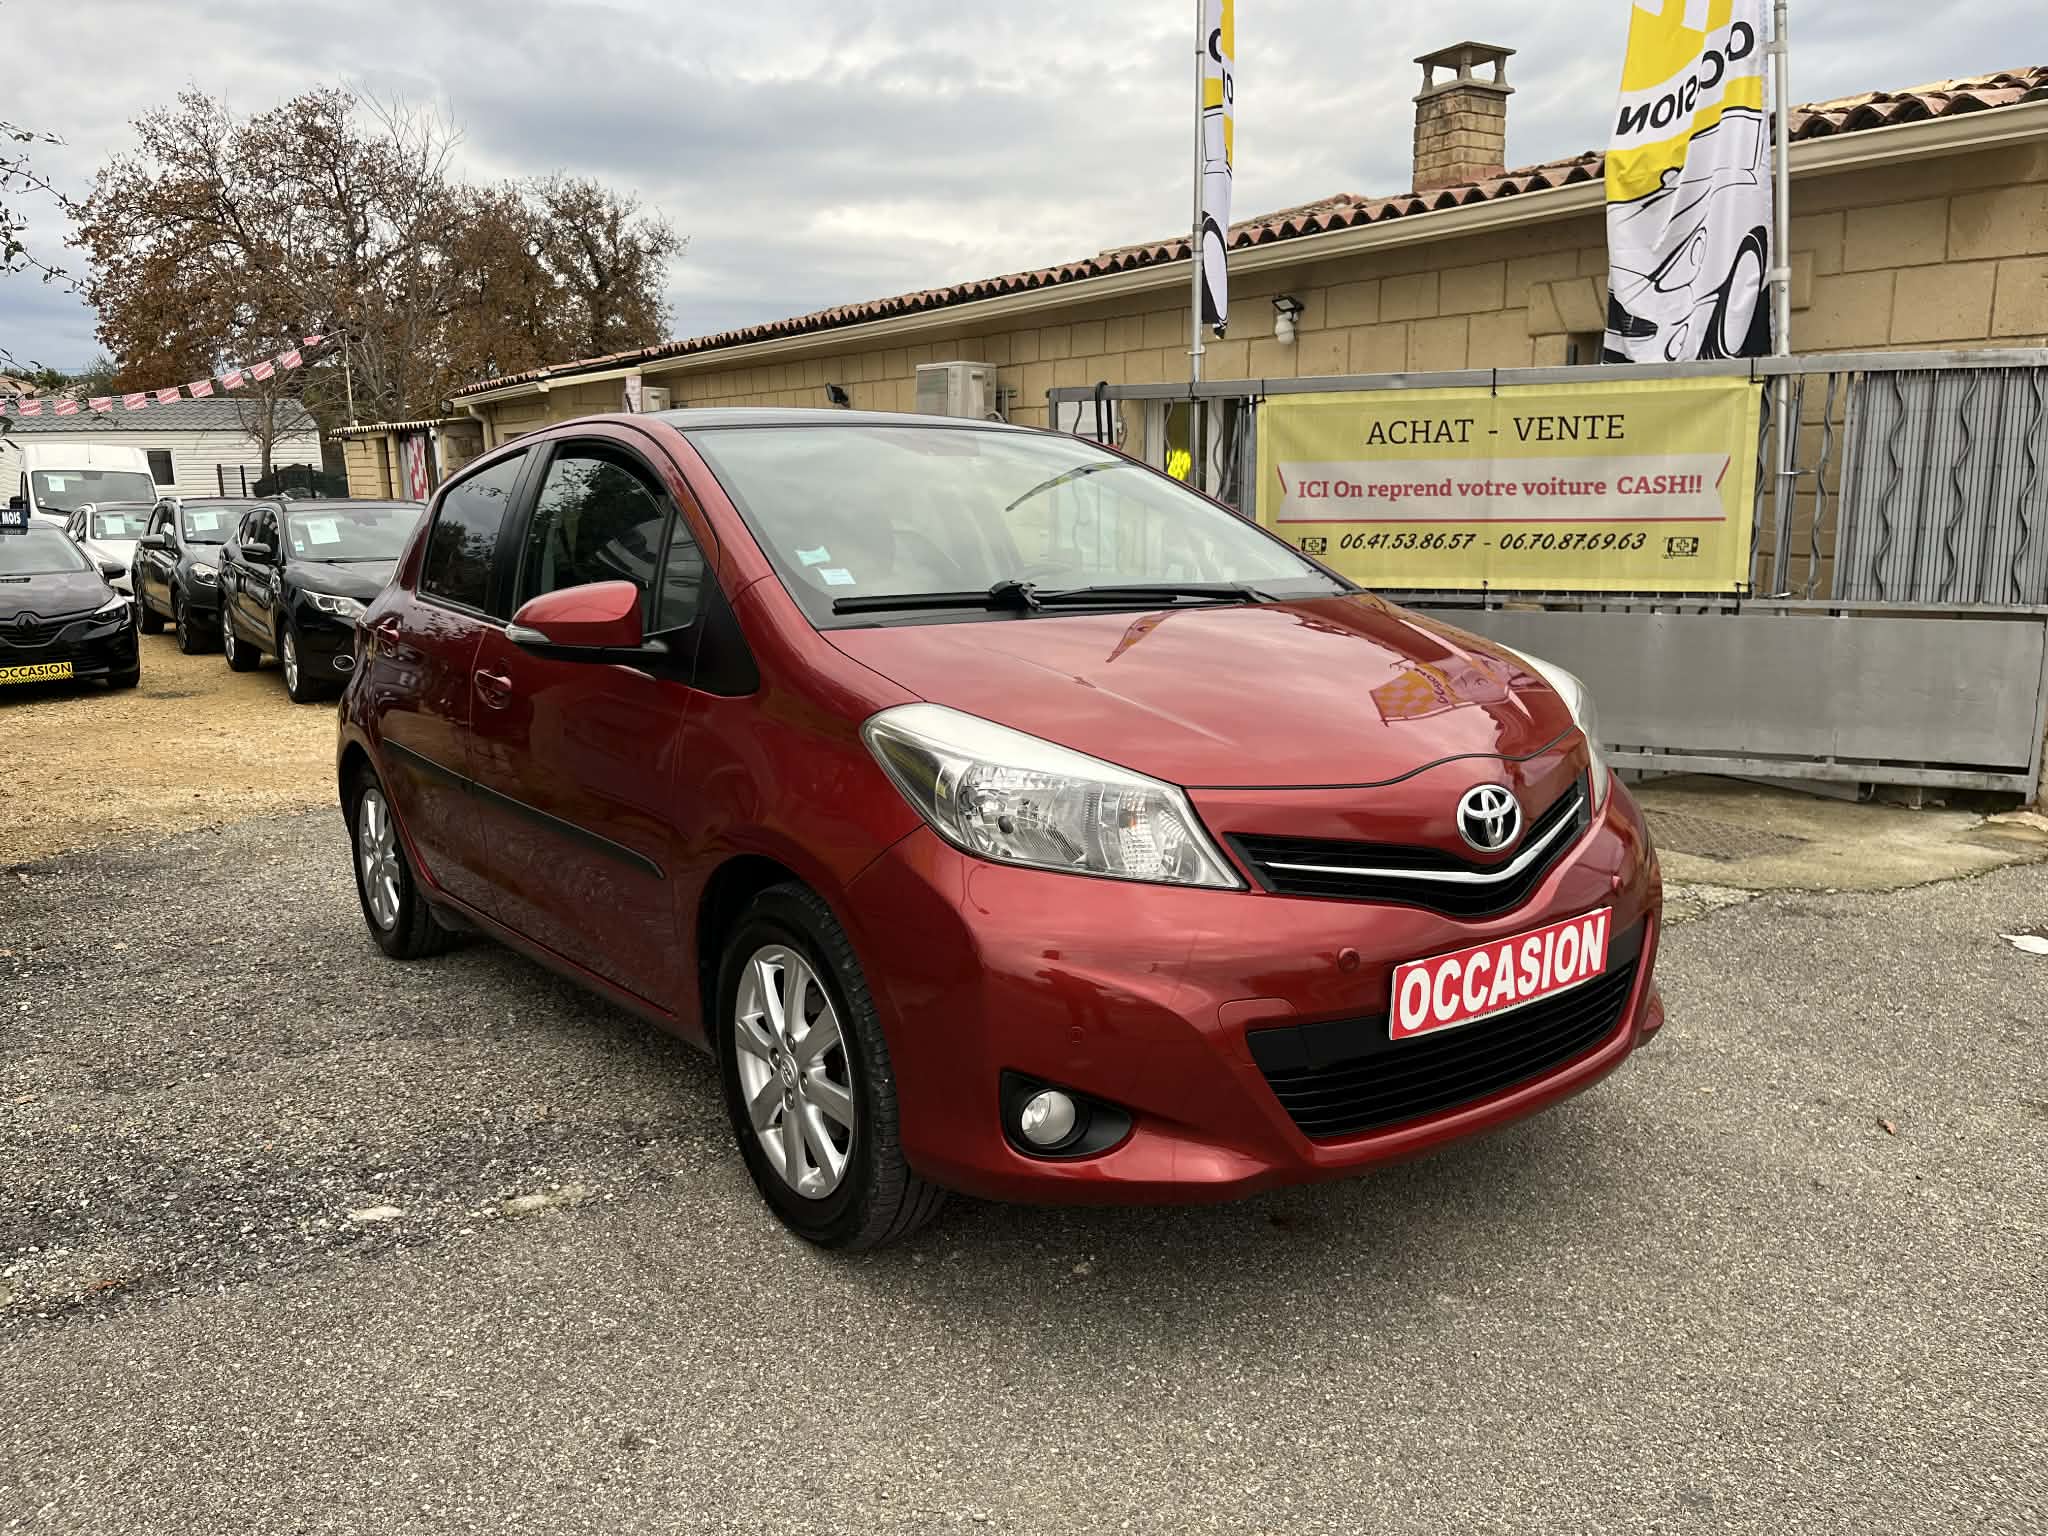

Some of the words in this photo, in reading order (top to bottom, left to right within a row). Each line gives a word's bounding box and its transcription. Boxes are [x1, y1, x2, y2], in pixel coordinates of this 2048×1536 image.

[1366, 419, 1474, 444] ACHAT
[1513, 415, 1625, 441] VENTE
[1298, 481, 1329, 498] ICI
[1334, 480, 1362, 497] On
[1367, 478, 1452, 501] reprend
[1457, 480, 1517, 497] votre
[1522, 477, 1607, 496] voiture
[1617, 475, 1702, 495] CASH!!
[2, 511, 21, 525] MOIS
[1340, 533, 1477, 550] 06.41.53.86.57
[1500, 532, 1647, 550] 06.70.87.69.63
[0, 663, 72, 678] OCCASION
[1400, 916, 1605, 1031] OCCASION
